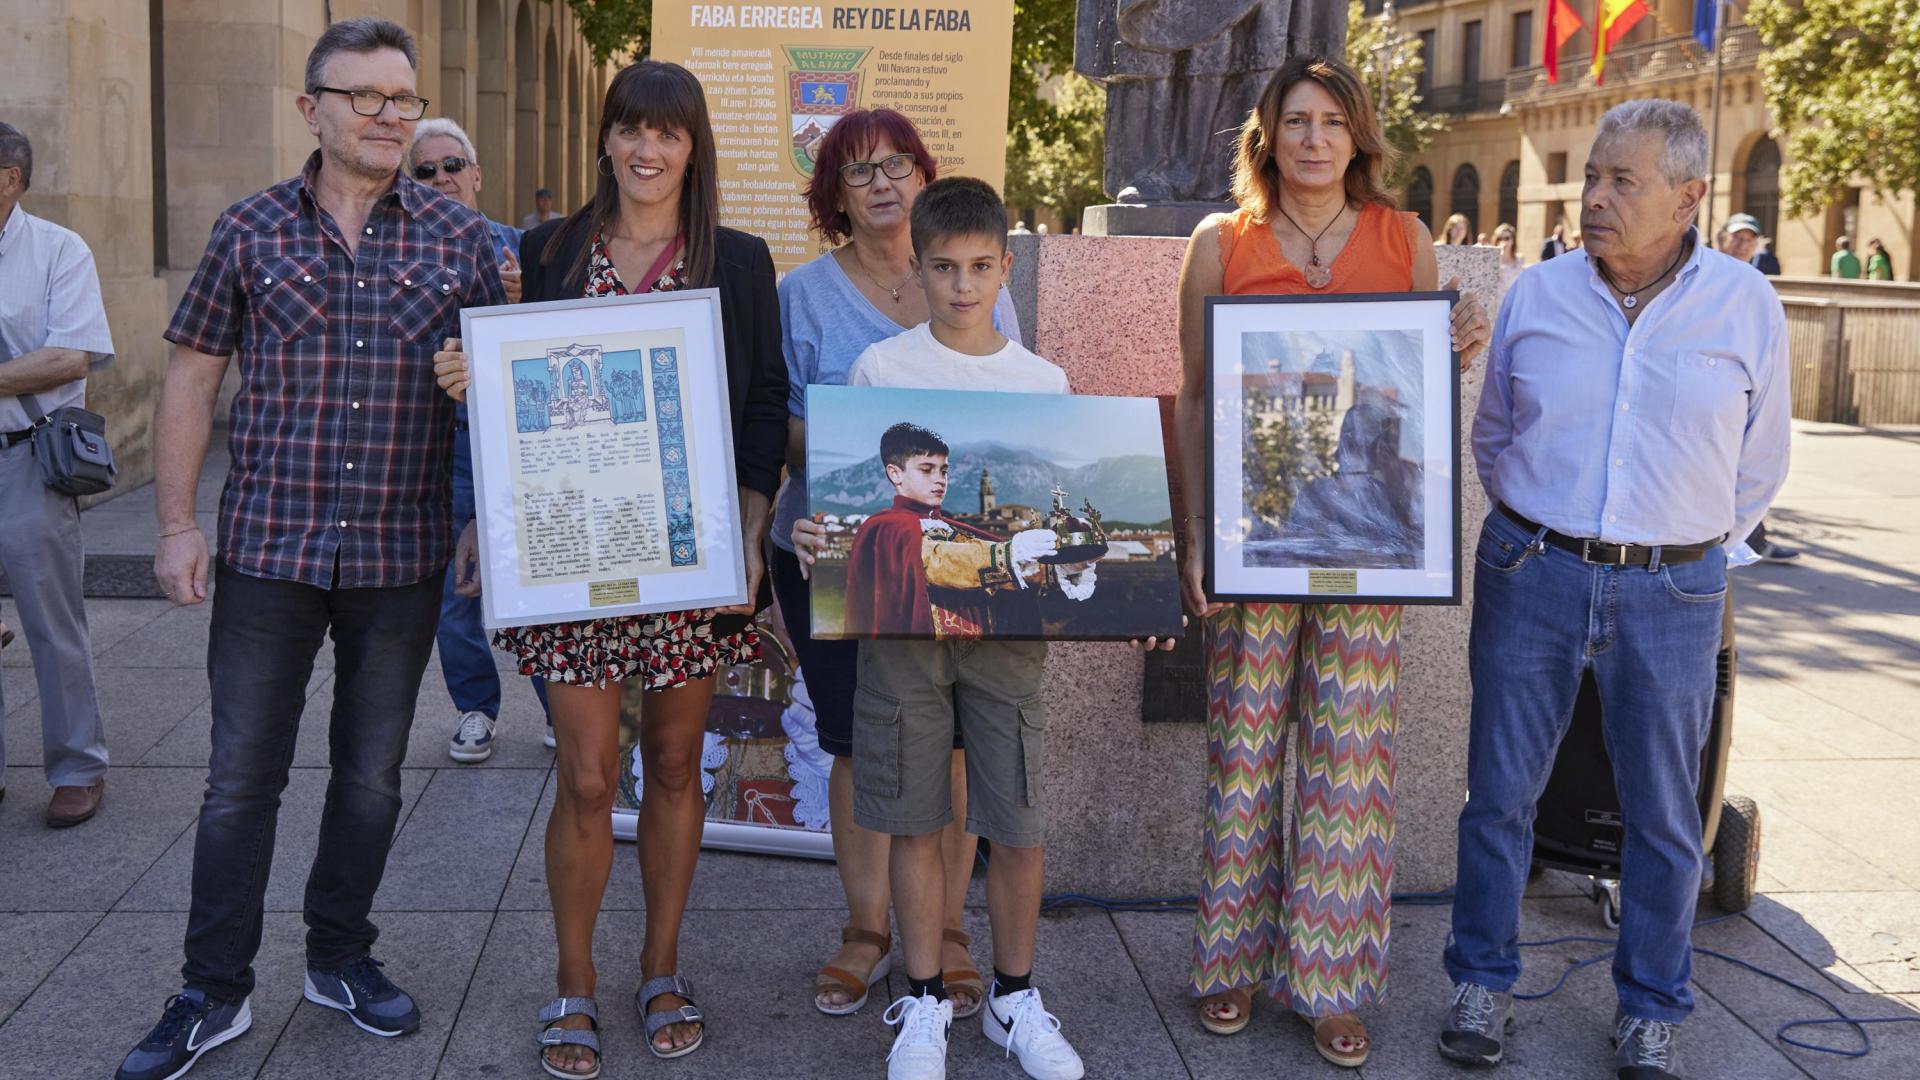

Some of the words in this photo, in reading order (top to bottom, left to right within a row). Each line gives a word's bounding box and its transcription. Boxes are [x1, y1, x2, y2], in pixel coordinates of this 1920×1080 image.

[691, 5, 736, 27] FABA
[740, 6, 823, 29] ERREGEA
[832, 8, 869, 30] REY
[871, 8, 896, 30] DE
[900, 9, 921, 31] LA
[925, 9, 971, 32] FABA
[880, 50, 902, 60] Desde
[904, 51, 930, 61] finales
[931, 52, 943, 61] del
[945, 52, 963, 63] siglo
[877, 63, 889, 73] VIII
[891, 63, 920, 74] Navarra
[922, 65, 948, 74] estuvo
[875, 76, 924, 87] proclamando
[872, 90, 912, 99] coronando
[935, 92, 964, 102] propios
[904, 104, 938, 113] conserva
[940, 104, 947, 113] el
[945, 118, 956, 126] en
[952, 131, 962, 139] en
[931, 143, 946, 151] con
[947, 142, 955, 151] la
[940, 155, 966, 165] brazos
